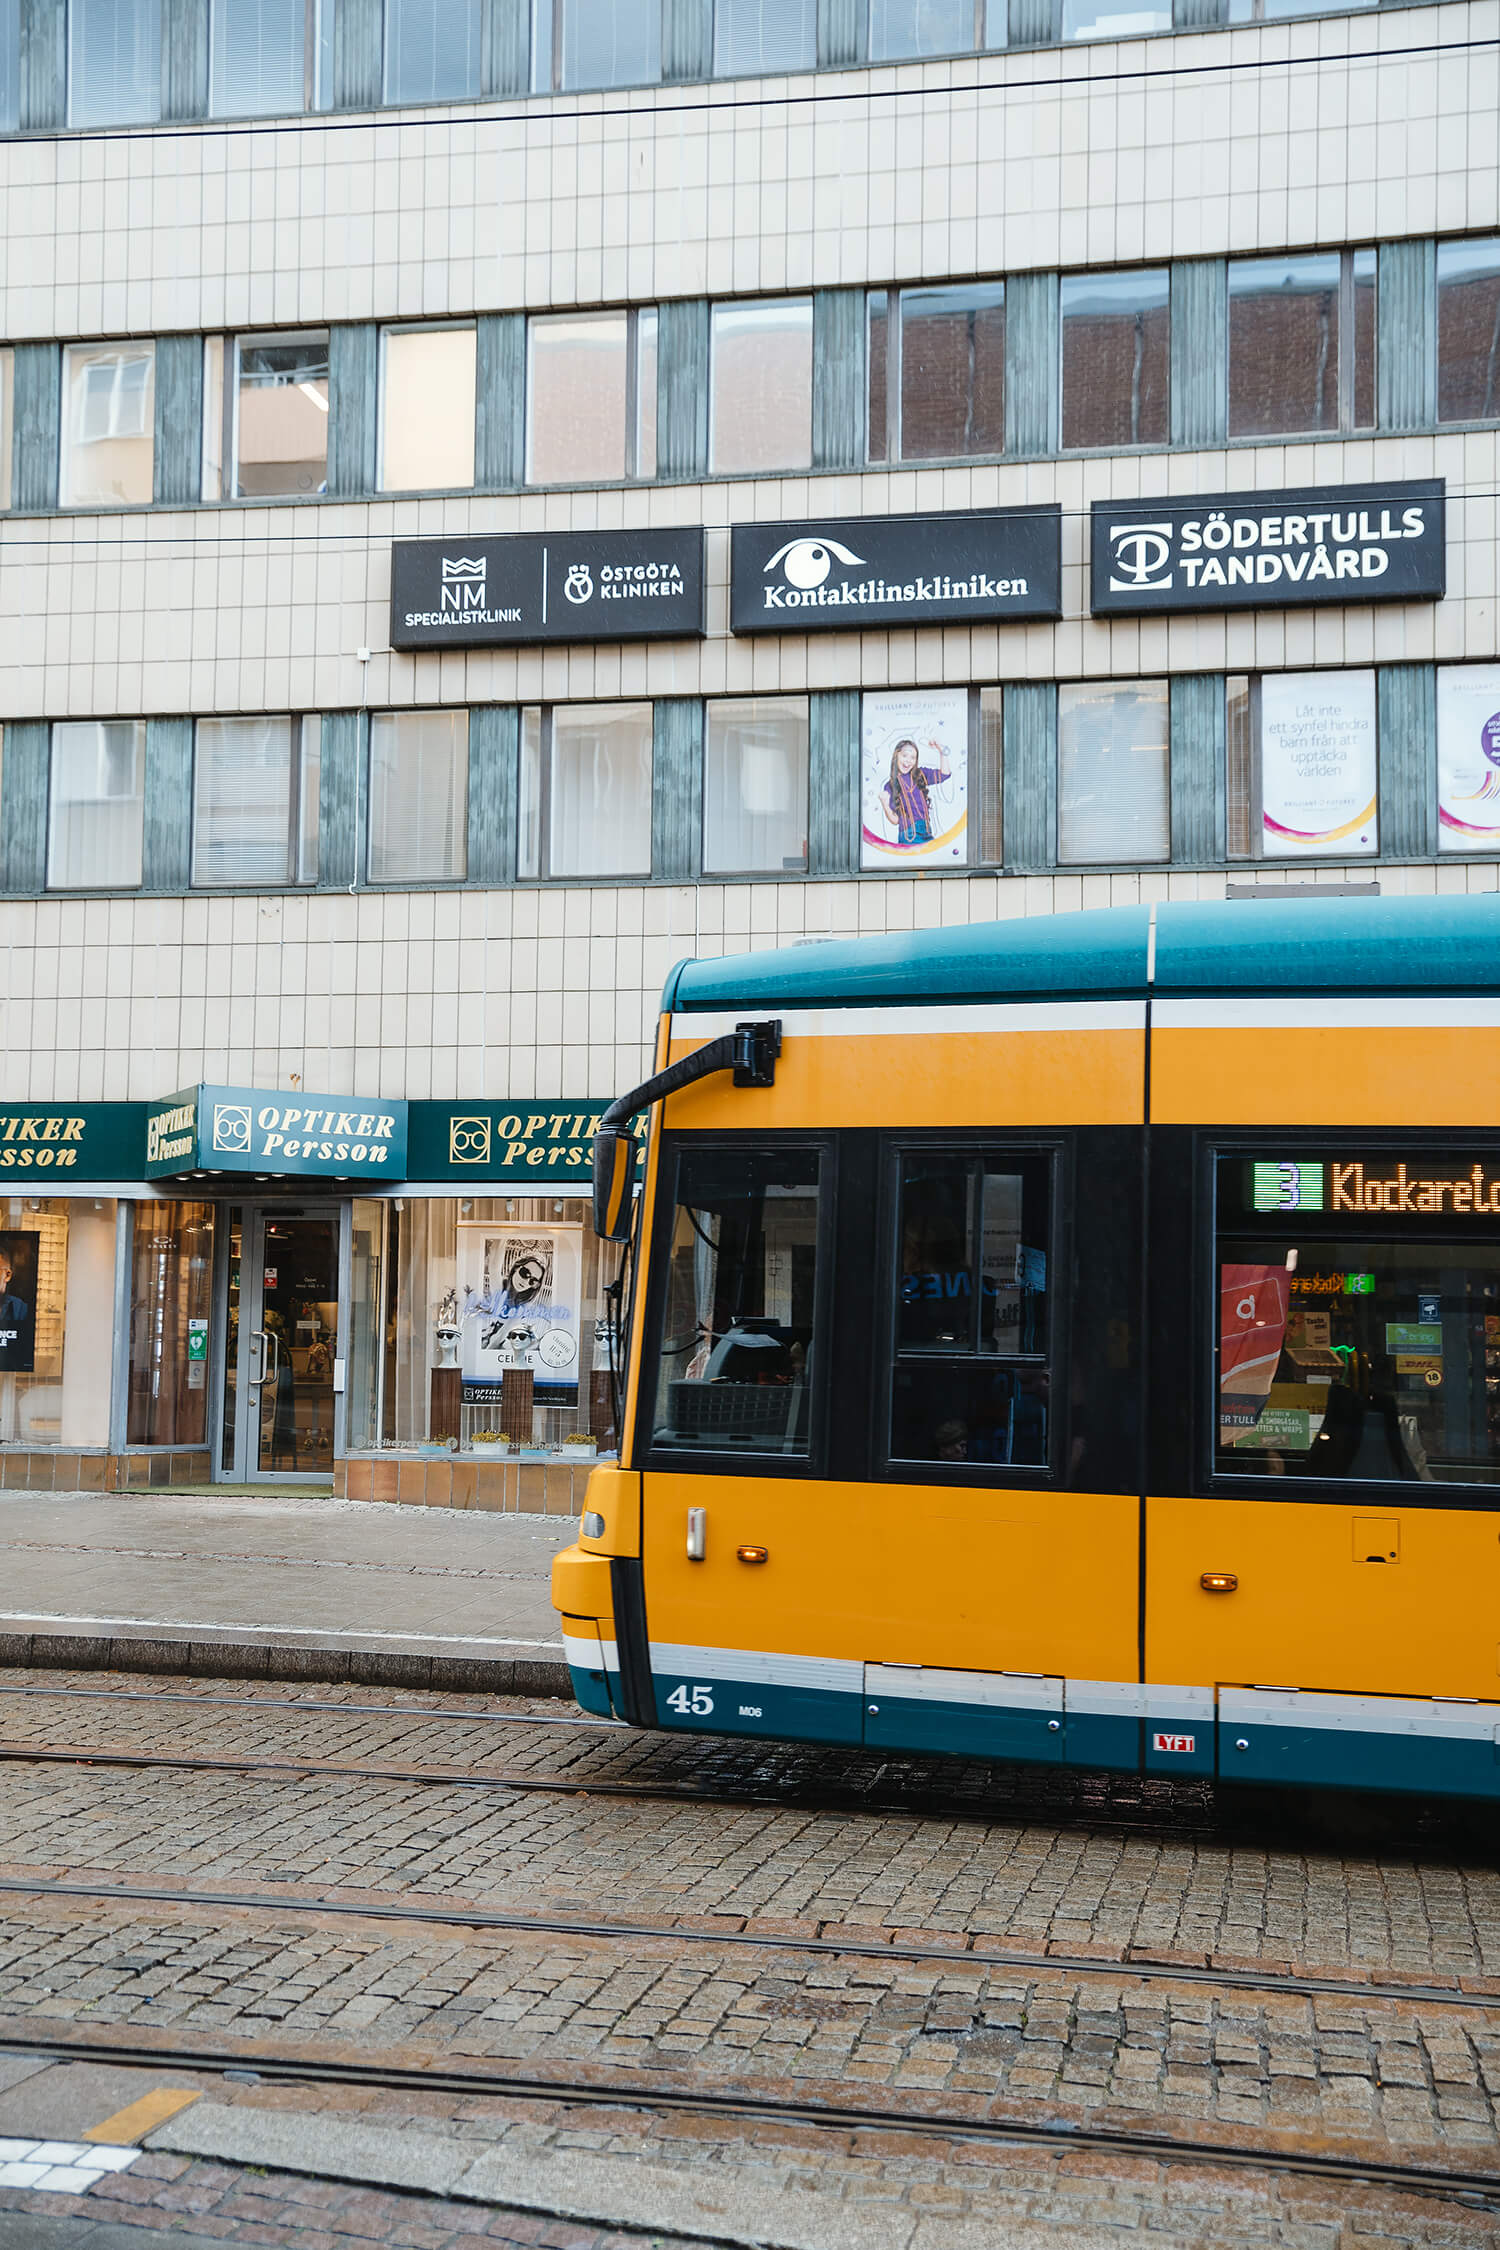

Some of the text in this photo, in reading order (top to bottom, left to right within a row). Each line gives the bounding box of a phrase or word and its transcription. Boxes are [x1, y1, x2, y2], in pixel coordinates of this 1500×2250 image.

[1180, 508, 1425, 551] SÖDERTULLS
[600, 563, 681, 581] ÖSTGÖTA
[1179, 546, 1389, 587] TANDVÅRD
[440, 583, 486, 611] NM
[600, 581, 684, 600] KLINIKEN
[763, 574, 1028, 609] Kontaktlinskliniken
[404, 608, 522, 626] SPECIALISTKLINIK
[1295, 705, 1342, 718] Låt inte
[1269, 717, 1369, 736] ett synfel hindra
[1311, 734, 1336, 747] från
[1340, 735, 1358, 746] att
[1290, 750, 1348, 765] upptäcka
[1296, 764, 1342, 777] världen
[0, 1117, 86, 1141] IKER
[159, 1104, 195, 1136] OPTIKER
[257, 1107, 395, 1139] OPTIKER
[497, 1114, 648, 1139] OPTIKR
[159, 1136, 193, 1160] Persson
[261, 1133, 389, 1163] Persson
[501, 1142, 646, 1166] Perssn
[1278, 1162, 1300, 1210] 3
[1427, 1373, 1439, 1382] 18
[666, 1684, 714, 1716] 45
[1155, 1734, 1194, 1752] LYFT
